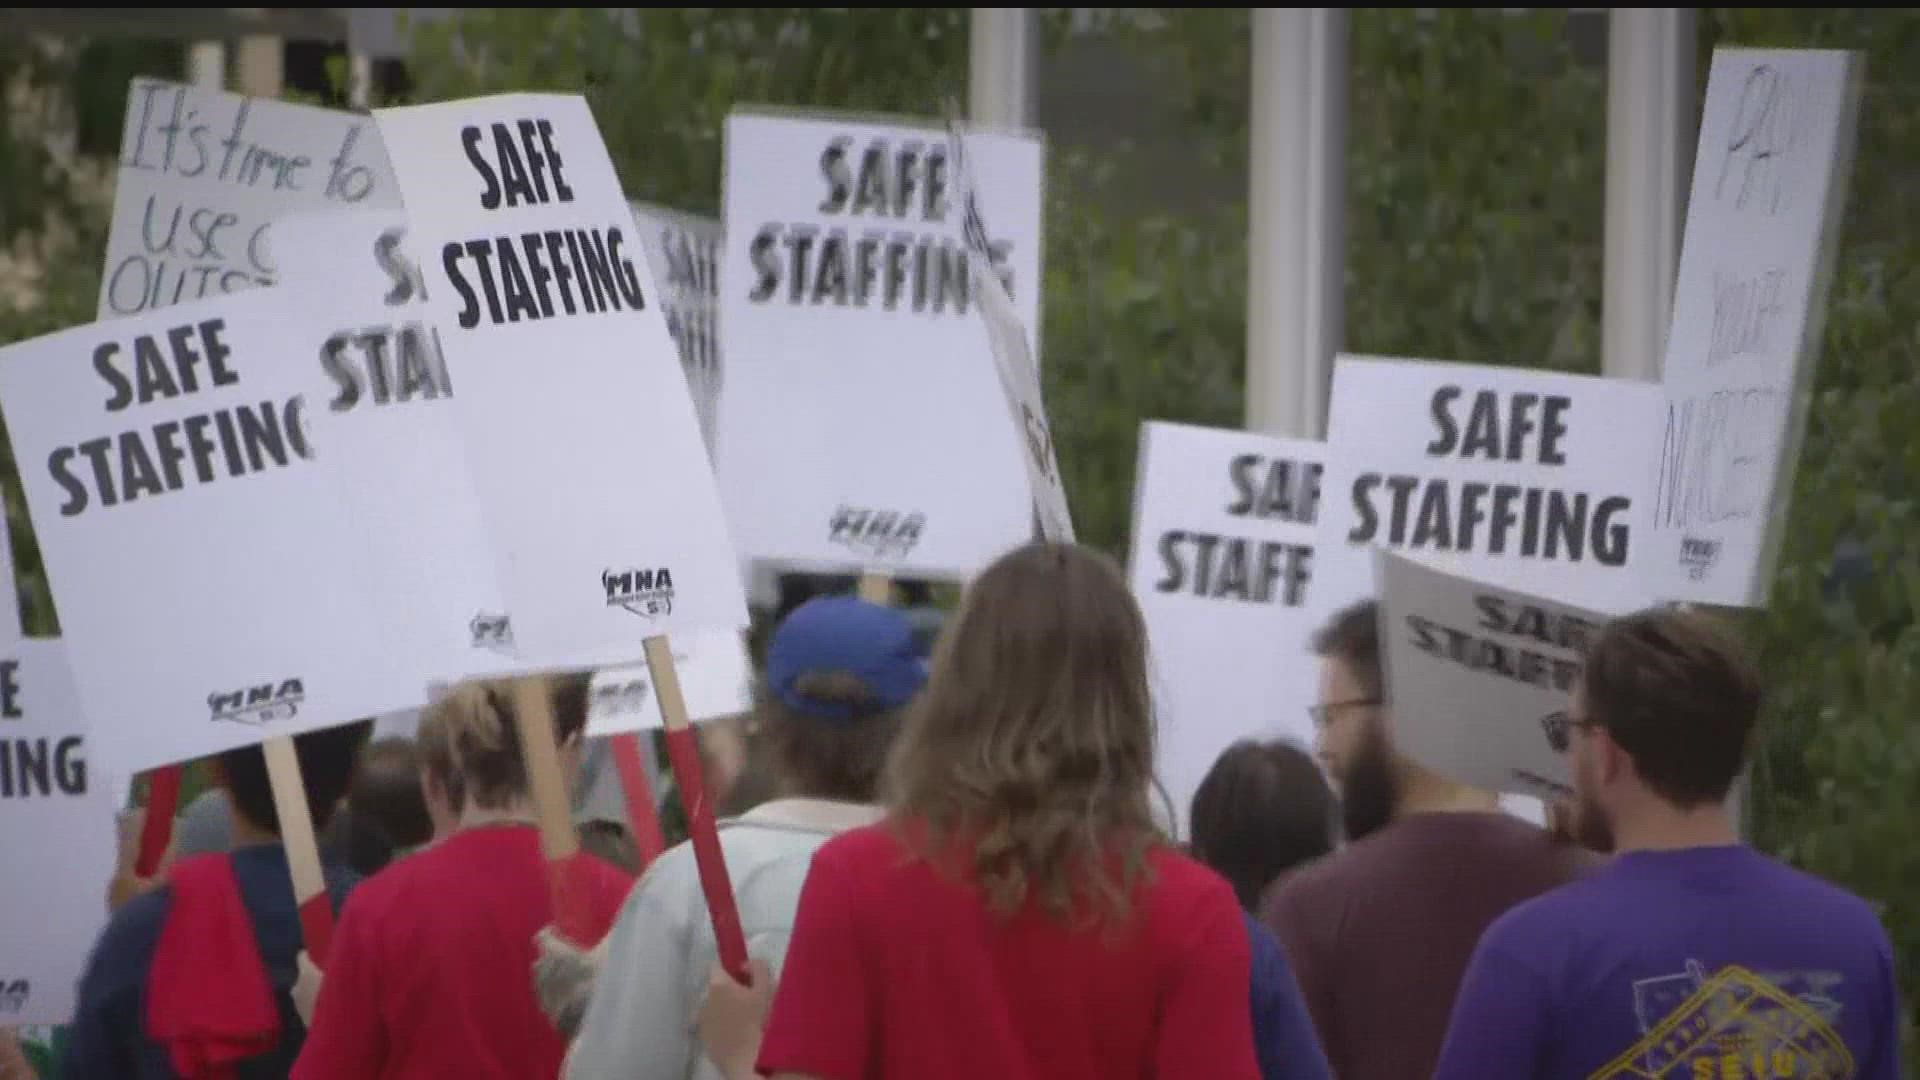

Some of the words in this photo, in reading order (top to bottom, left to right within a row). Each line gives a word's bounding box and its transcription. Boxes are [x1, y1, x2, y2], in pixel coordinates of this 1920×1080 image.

[461, 118, 574, 210] SAFE
[818, 135, 948, 222] SAFE
[442, 226, 645, 330] STAFFING
[92, 318, 239, 412] SAFE
[1426, 384, 1572, 466] SAFE
[1346, 472, 1632, 567] STAFFING
[603, 567, 673, 597] MNA
[208, 678, 304, 714] MNA
